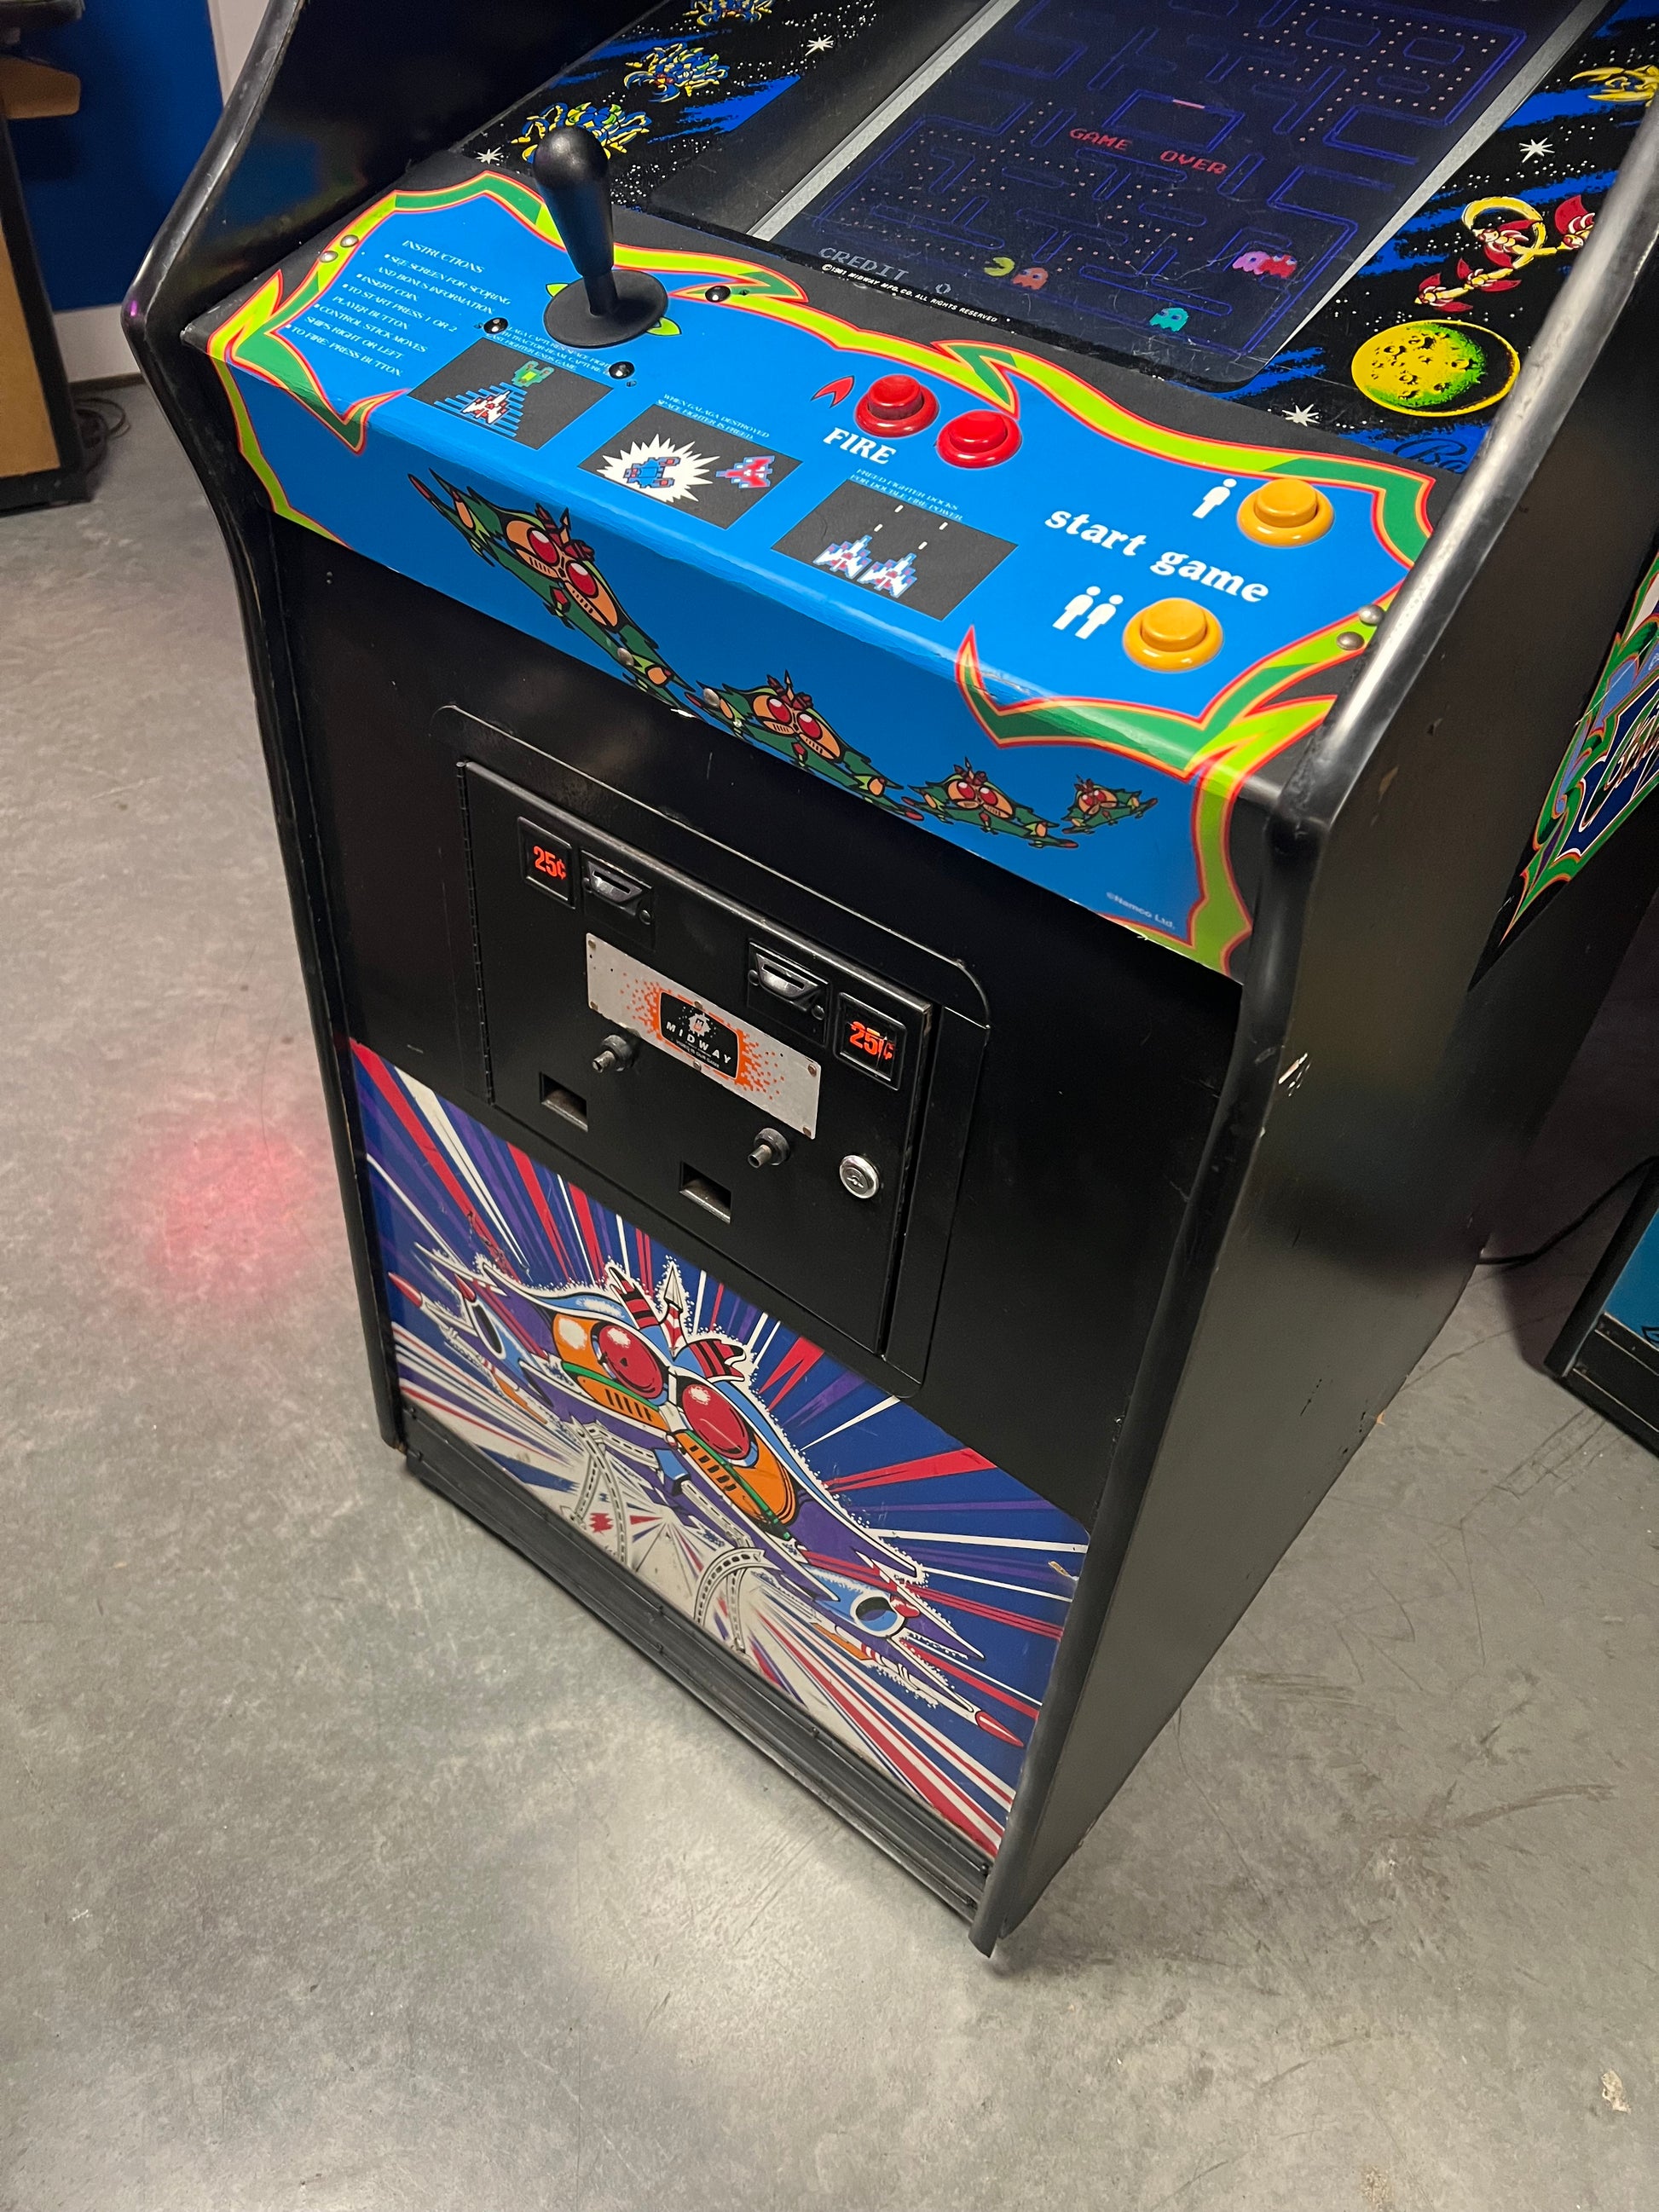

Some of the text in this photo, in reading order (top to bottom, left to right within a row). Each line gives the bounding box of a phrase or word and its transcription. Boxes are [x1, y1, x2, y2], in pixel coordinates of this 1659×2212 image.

[1069, 128, 1228, 175] GAME OVER
[402, 240, 485, 274] INSTRUCTIONS
[818, 247, 951, 295] CREDIT 0
[361, 275, 396, 293] INSERT
[378, 266, 494, 315] AND BONUS INFORMATION
[390, 256, 512, 306] SEE SCREEN FOR SCORING
[822, 263, 998, 324] ©1981 MIDWAY MFG. CO. ALL RIGHTS RESERVED
[332, 295, 368, 314] PLAYER
[349, 286, 362, 296] TO
[361, 291, 391, 308] START
[392, 303, 425, 320] PRESS
[432, 319, 448, 330] OR
[291, 326, 306, 338] TO
[329, 343, 361, 359] PRESS
[305, 315, 332, 331] SHIPS
[331, 326, 363, 343] RIGHT
[361, 338, 377, 349] OR
[319, 306, 429, 353] CONTROL STICK MOVES
[657, 399, 682, 411] SPACE
[682, 409, 716, 425] FIGHTER
[664, 393, 770, 438] WHEN GALAGA DESTROYED
[823, 427, 897, 465] FIRE
[850, 474, 963, 521] FOR DOUBLE FIRE POWER
[857, 469, 958, 511] FREED FIGHTER DOCKS
[1044, 510, 1269, 603] start game
[534, 846, 567, 881] 25¢
[666, 1021, 731, 1064] MIDWAY
